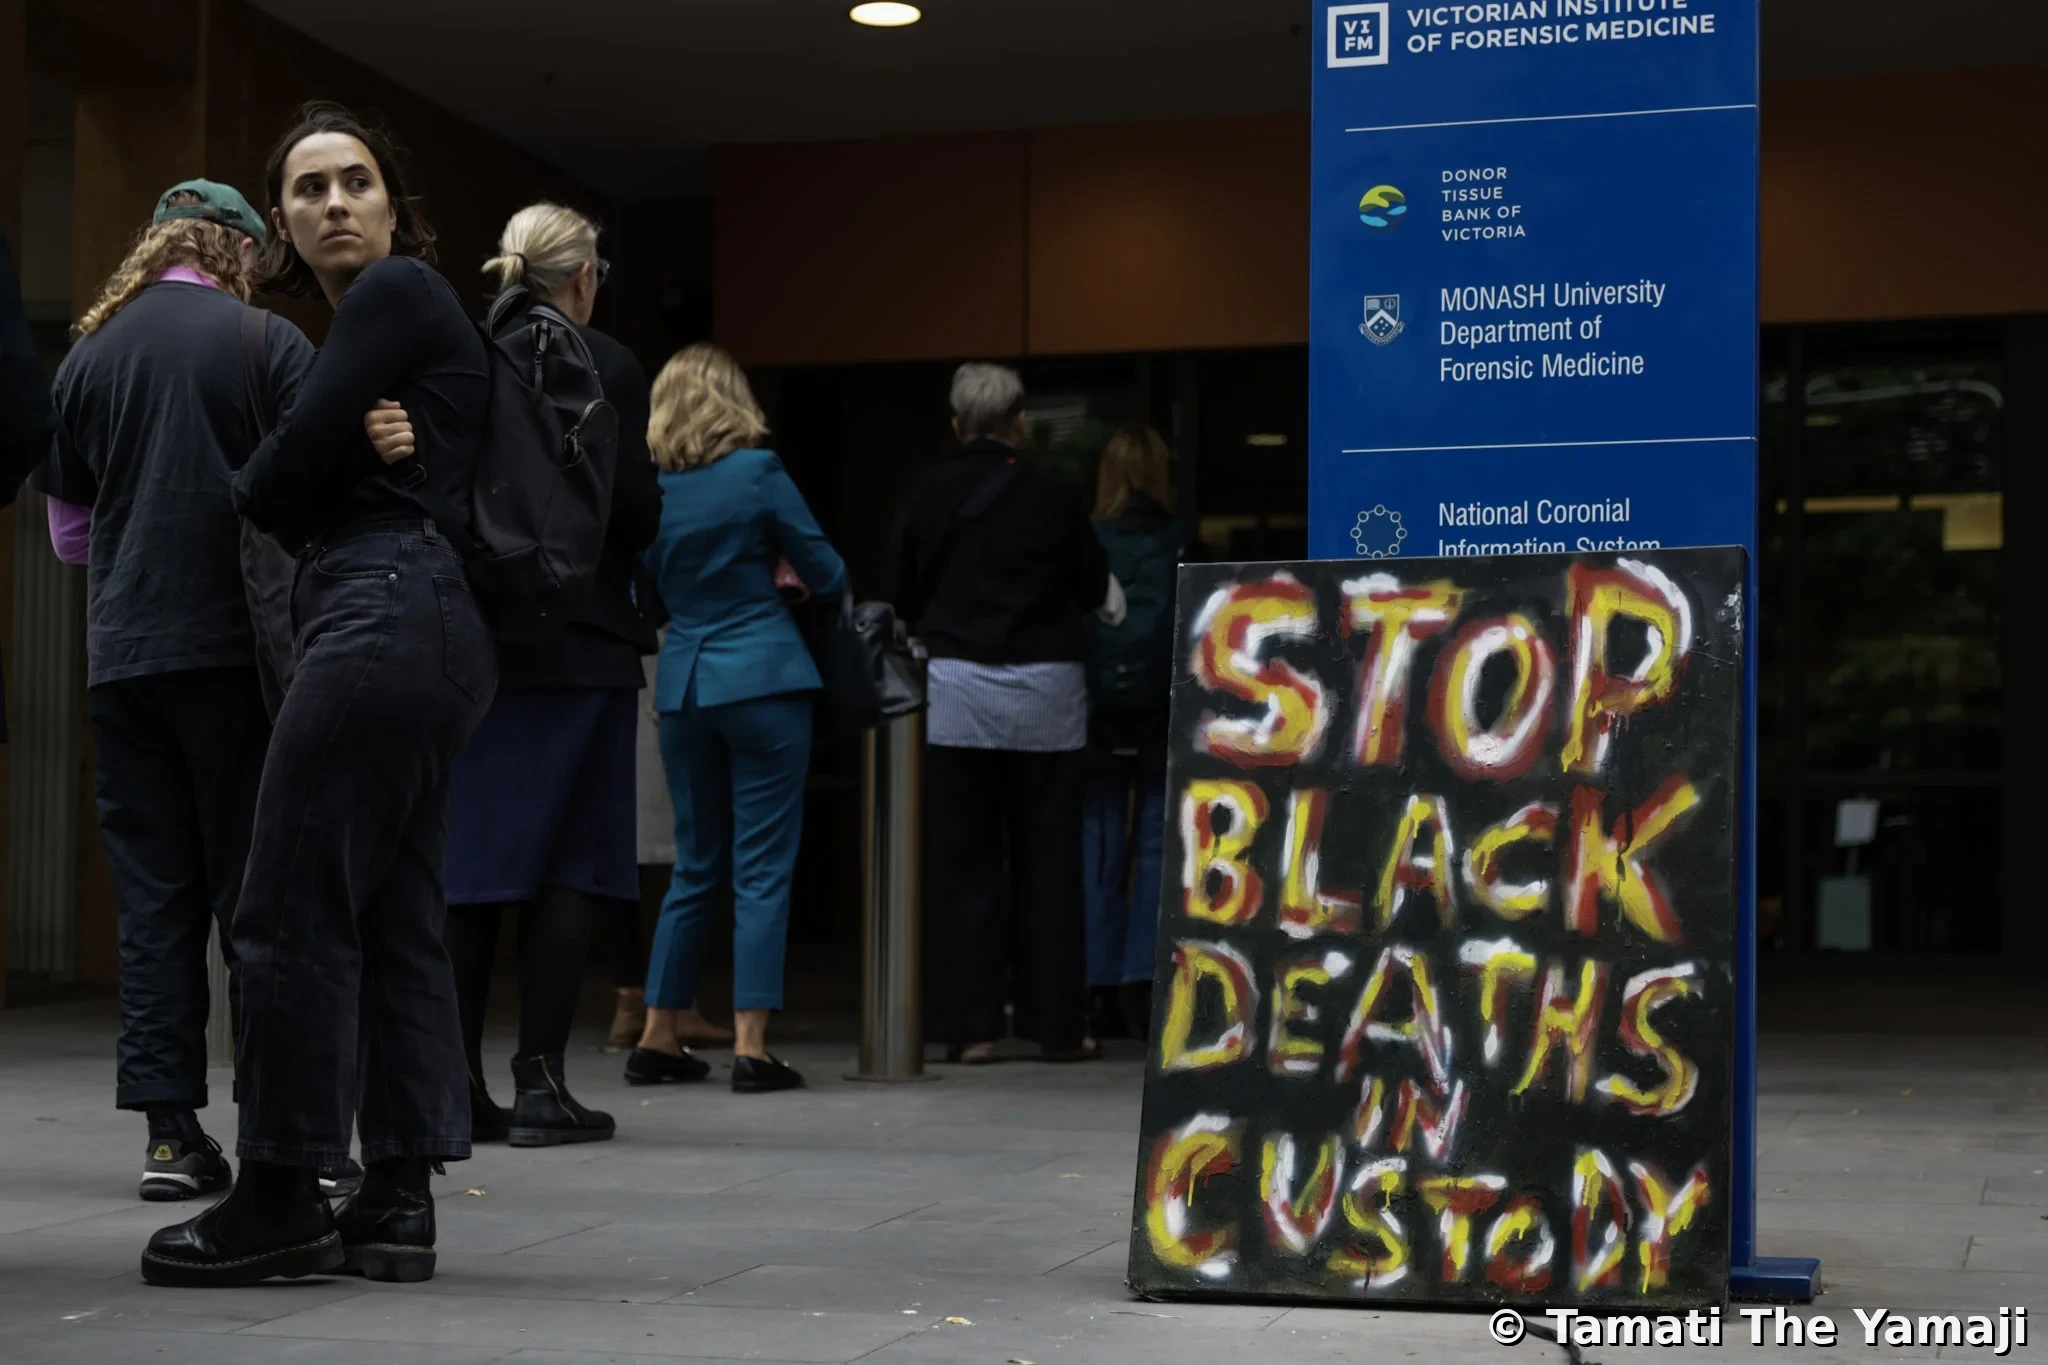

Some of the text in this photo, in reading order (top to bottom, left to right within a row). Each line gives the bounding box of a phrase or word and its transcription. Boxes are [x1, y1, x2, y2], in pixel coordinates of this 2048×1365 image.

[1343, 19, 1370, 35] VI
[1407, 0, 1550, 28] VICTORIAN
[1344, 35, 1373, 52] FM
[1406, 13, 1716, 53] OF FORENSIC MEDICINE
[1442, 167, 1507, 183] DONOR
[1441, 186, 1503, 203] TISSUE
[1442, 205, 1522, 222] BANK OF
[1441, 225, 1526, 242] VICTORIA
[1440, 279, 1666, 312] MONASH University
[1440, 317, 1573, 350] Department
[1579, 315, 1602, 340] of
[1440, 351, 1645, 382] Forensic Medicine
[1438, 497, 1631, 527] National Coronial
[1192, 558, 1692, 781] STOP
[1181, 776, 1699, 943] BLACK
[1162, 939, 1701, 1115] DEATHS
[1356, 1077, 1470, 1160] IN
[1147, 1113, 1711, 1294] CUSTODY
